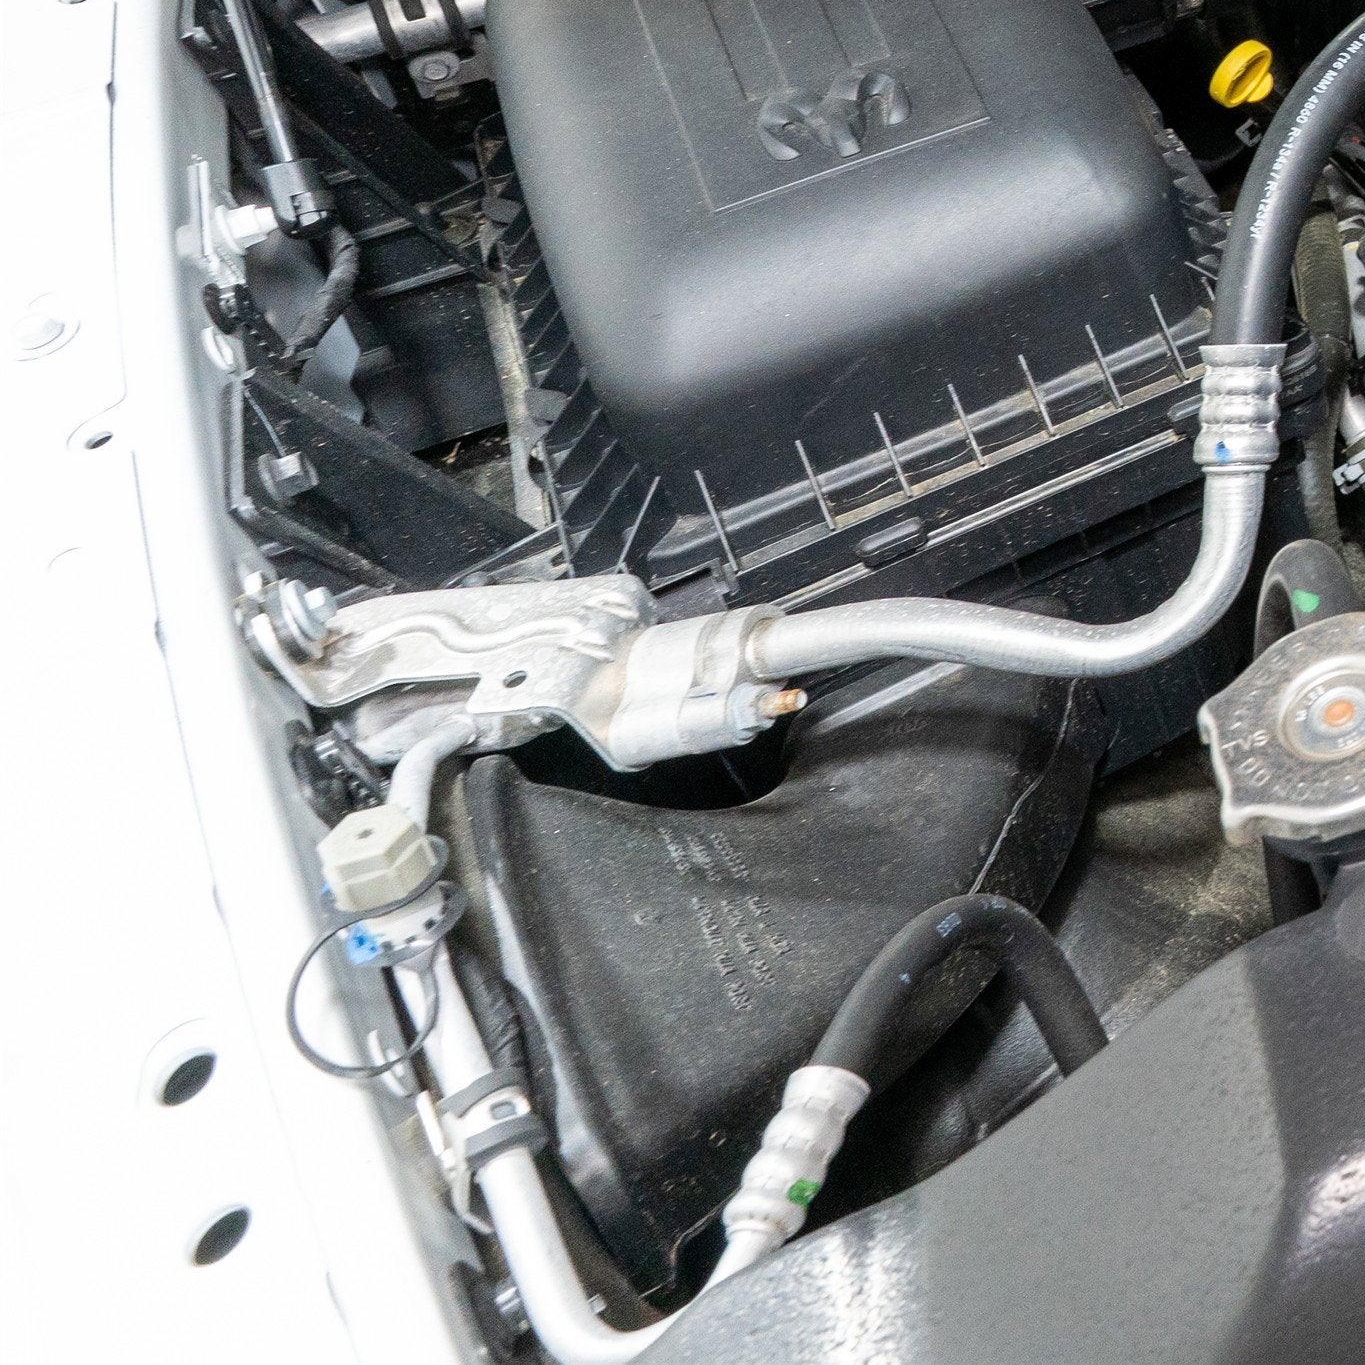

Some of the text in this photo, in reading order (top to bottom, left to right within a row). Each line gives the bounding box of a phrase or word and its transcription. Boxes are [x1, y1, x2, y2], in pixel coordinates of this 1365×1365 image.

[1346, 40, 1363, 53] IN
[1332, 52, 1352, 70] (16
[1312, 69, 1339, 93] MM)
